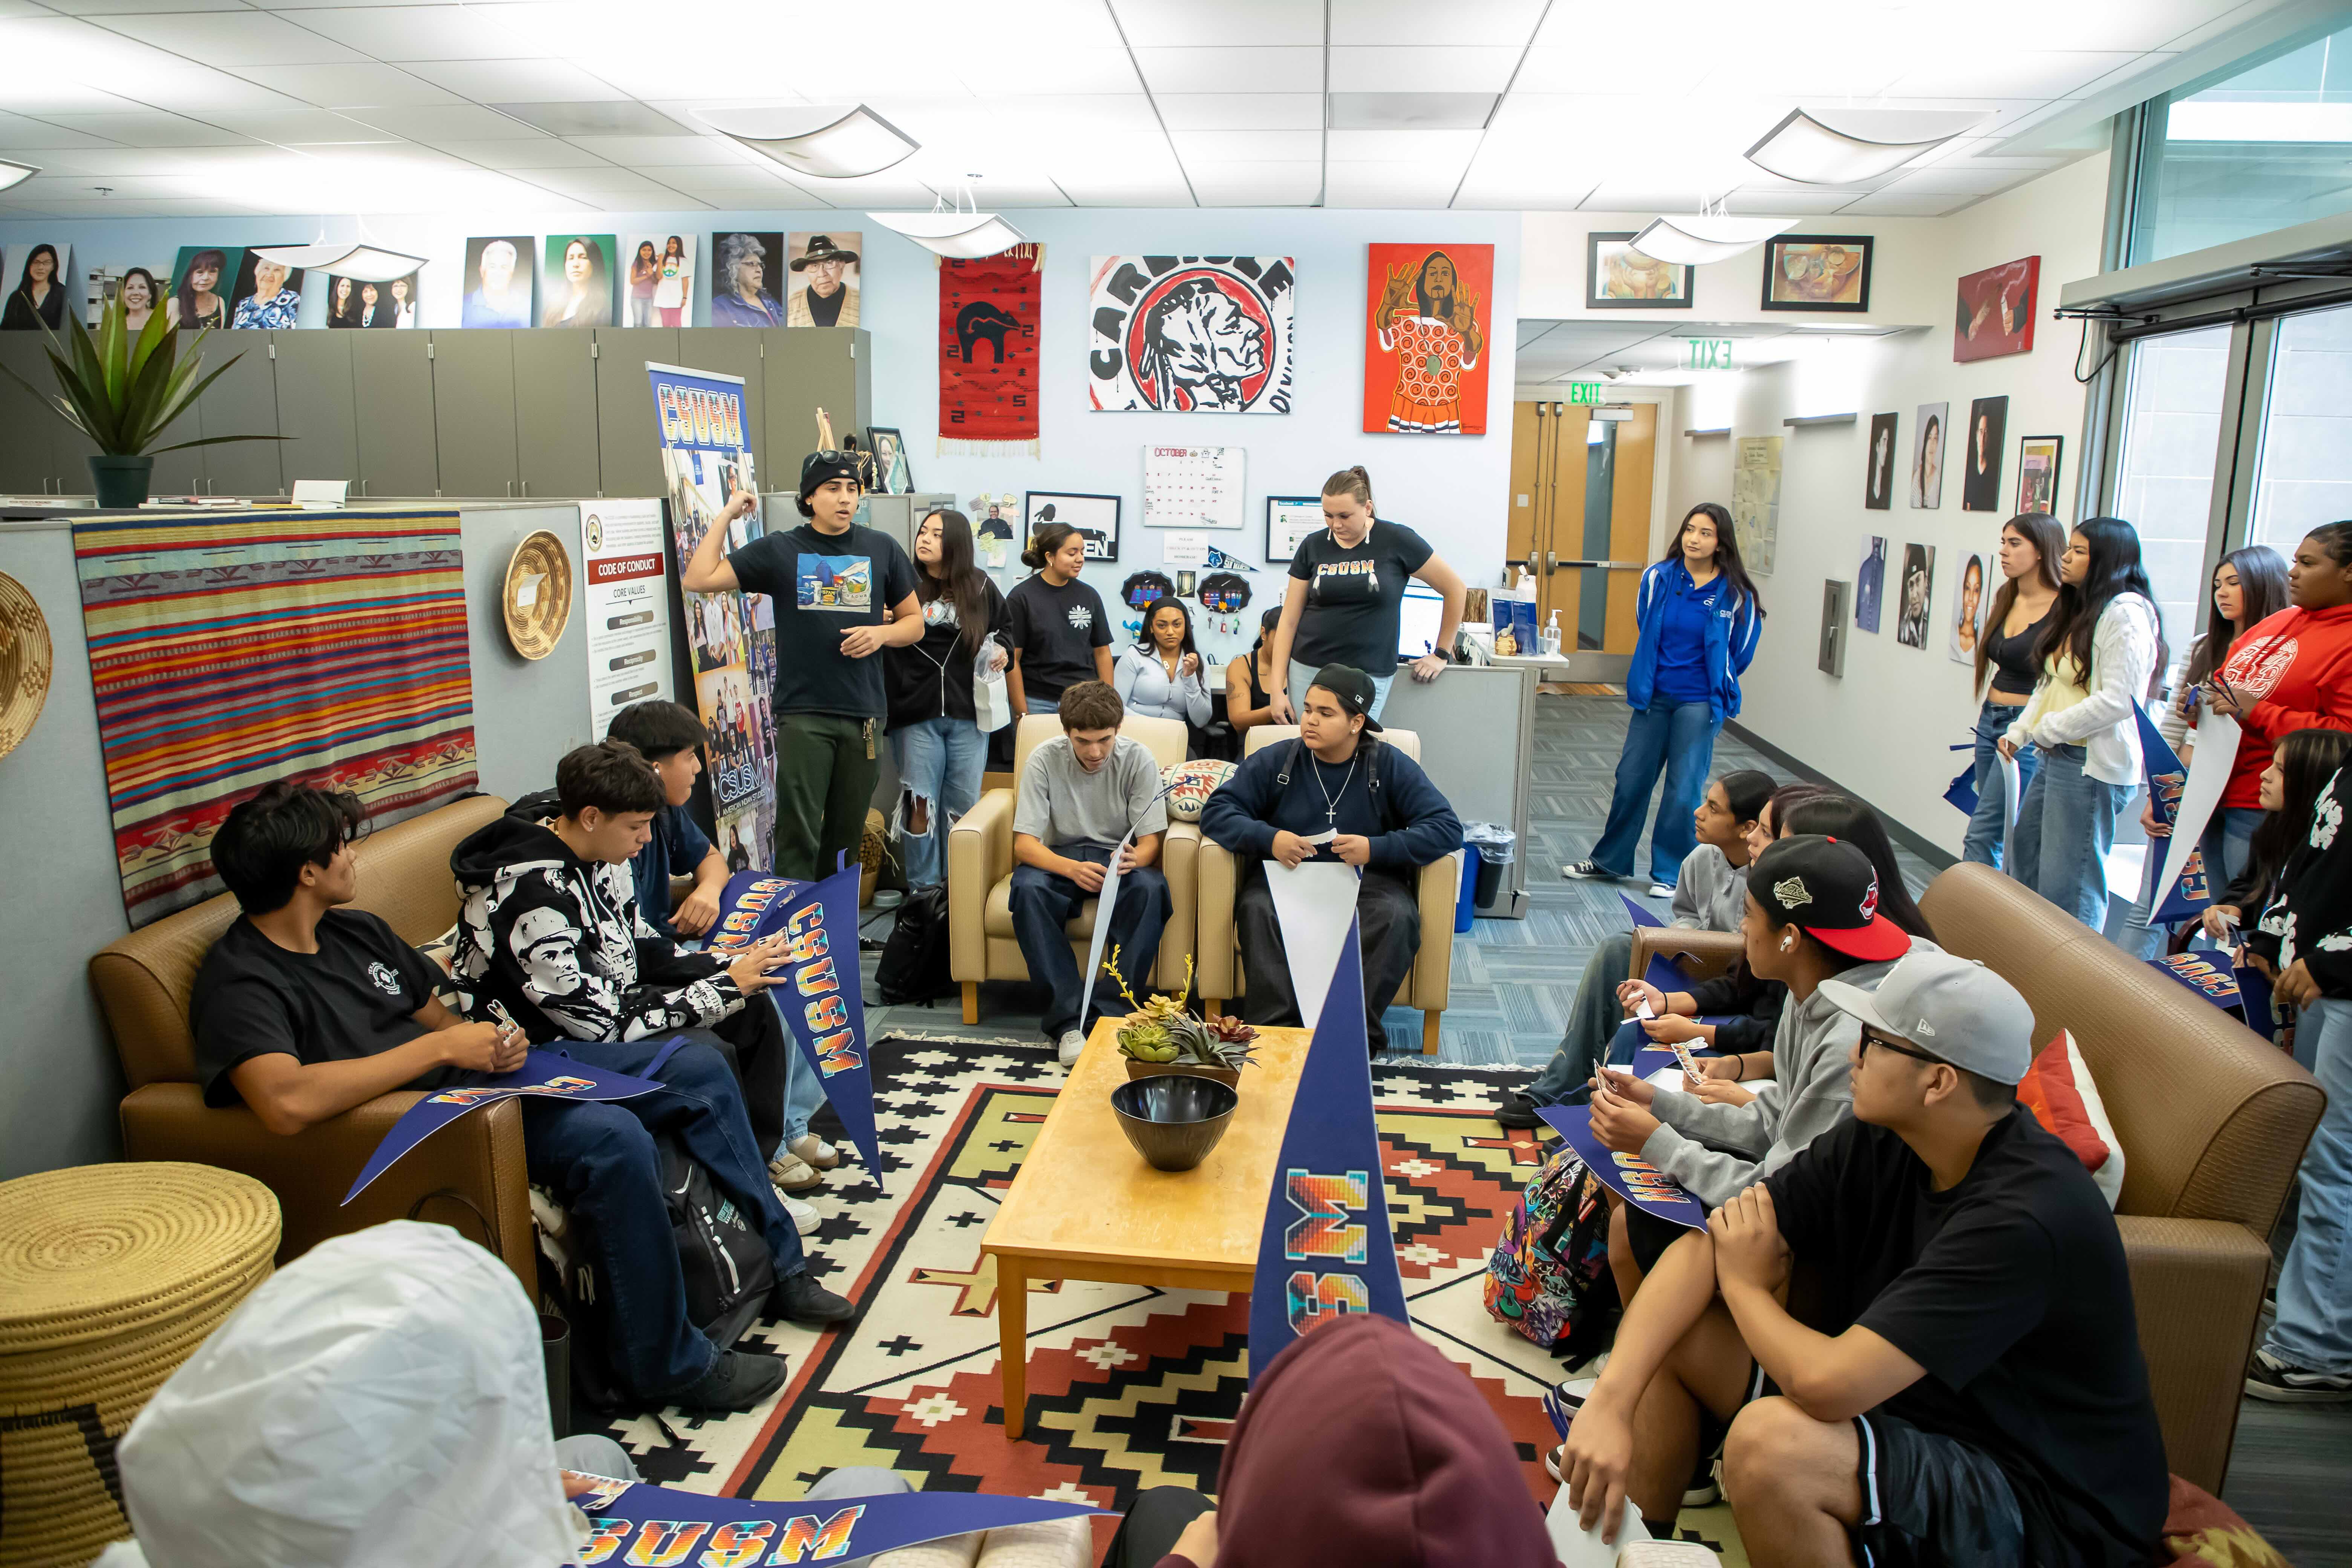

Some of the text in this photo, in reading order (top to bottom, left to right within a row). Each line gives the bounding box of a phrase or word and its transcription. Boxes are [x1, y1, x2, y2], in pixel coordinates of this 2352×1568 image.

[1571, 383, 1601, 403] EXIT
[658, 383, 744, 448] CSUSM
[1155, 447, 1187, 457] OCTOBER
[598, 558, 655, 576] CODE OF CONDUCT
[1317, 559, 1375, 576] CSUSM
[613, 585, 646, 598] CORE VALUES
[718, 758, 764, 802] CSUSM
[723, 800, 741, 816] AMERICAN
[741, 795, 752, 807] INDIAN
[752, 790, 766, 801] STUDIES
[788, 902, 864, 1079] CSUSM
[561, 1504, 867, 1568] SUSM
